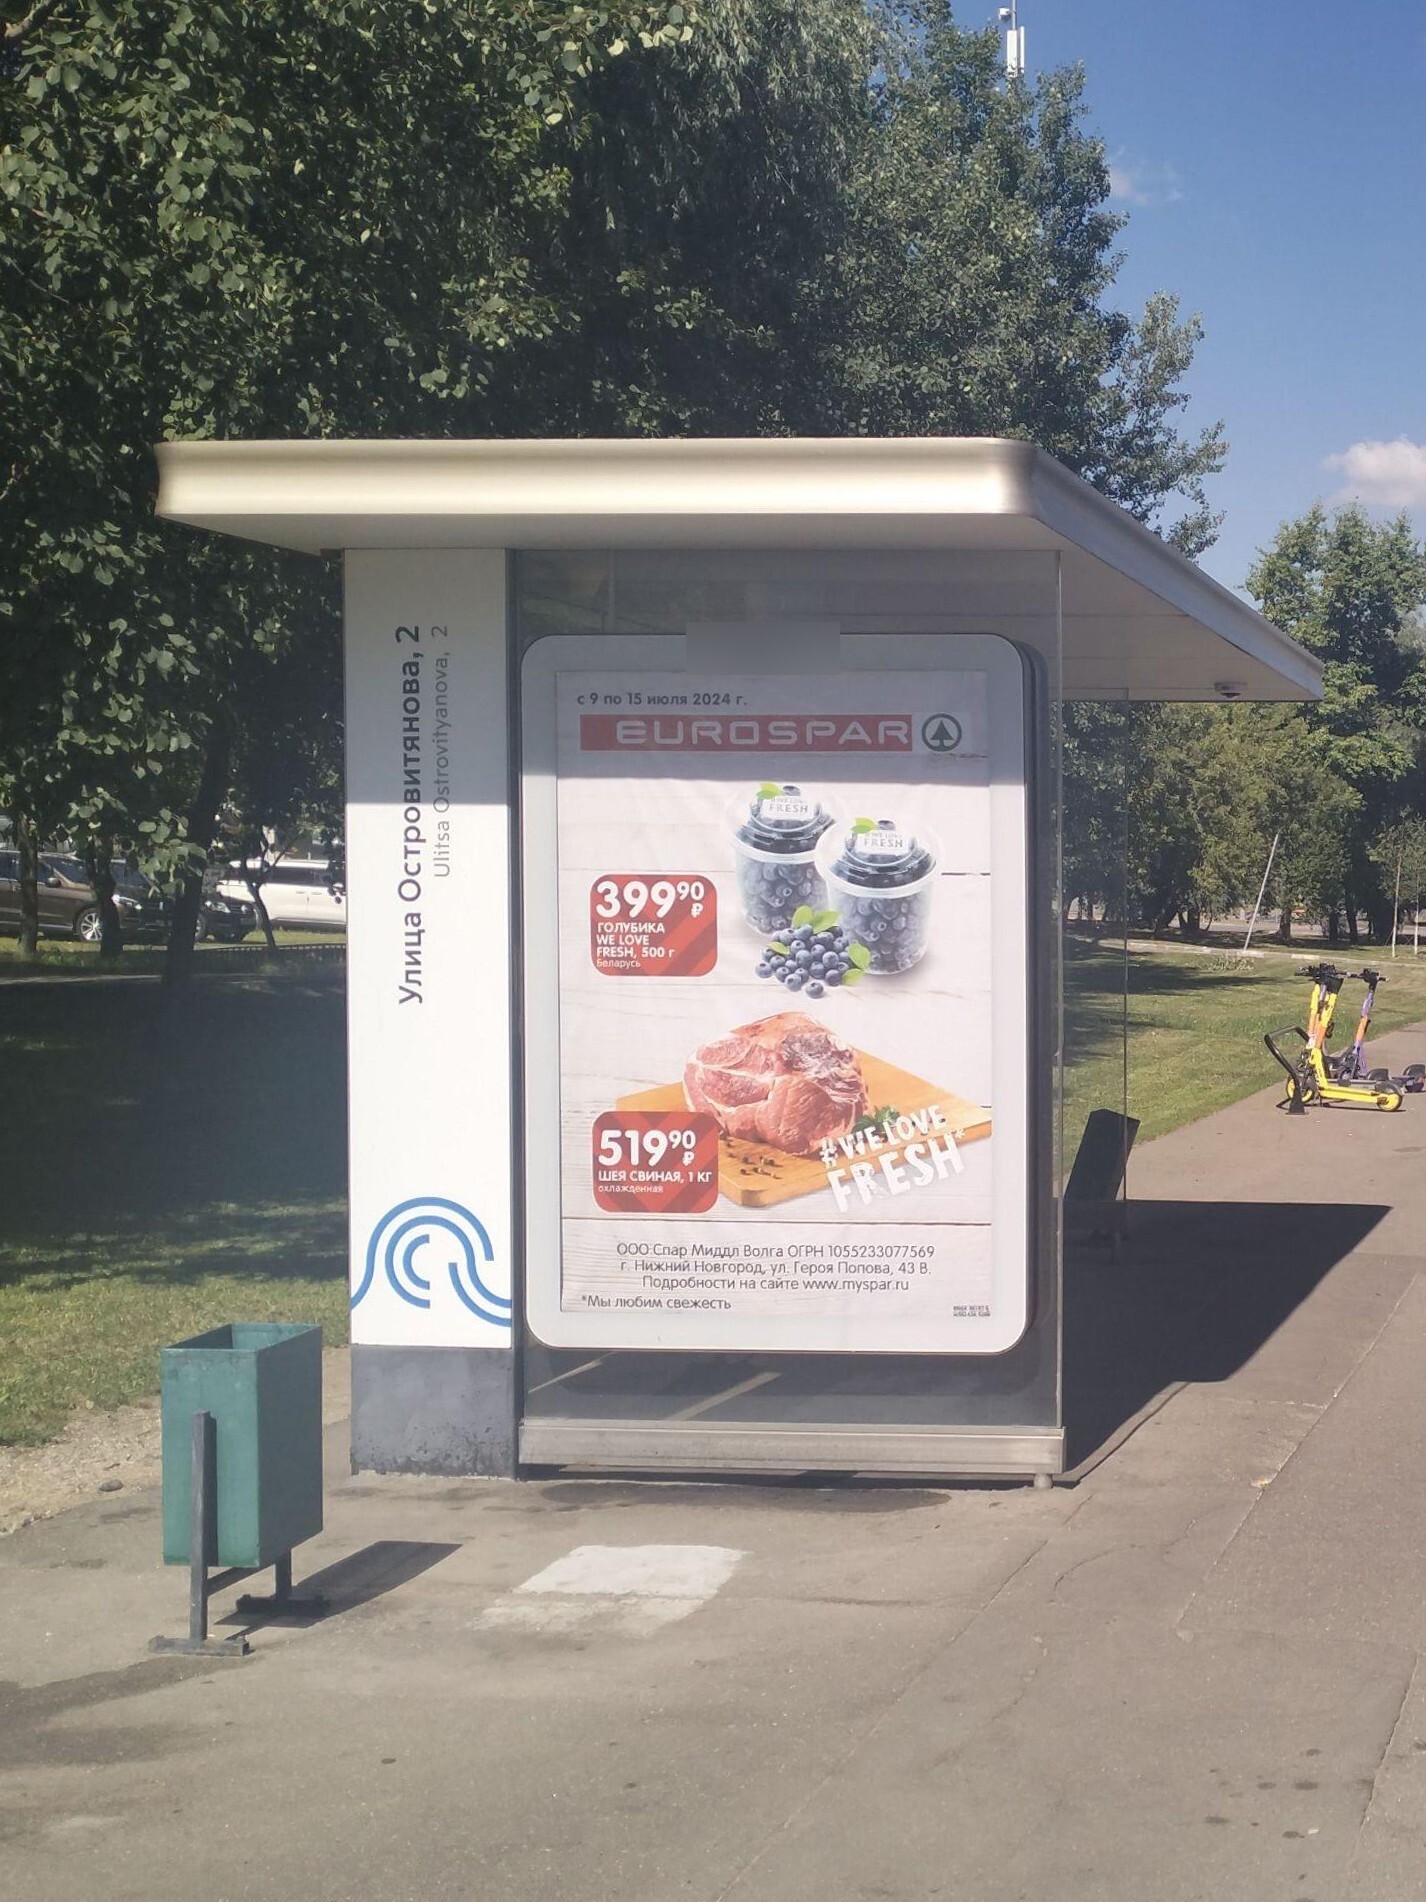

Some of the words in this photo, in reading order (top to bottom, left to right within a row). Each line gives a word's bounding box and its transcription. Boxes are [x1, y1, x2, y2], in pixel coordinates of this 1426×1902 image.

[395, 625, 420, 644] 2
[431, 625, 449, 638] 2
[590, 692, 599, 705] 9
[604, 694, 622, 705] по
[627, 692, 642, 705] 15
[647, 694, 688, 705] июля
[693, 692, 731, 705] 2024
[736, 694, 748, 706] г.
[432, 651, 452, 814] Ostrovityanova,
[616, 719, 909, 746] EUROSPAR
[397, 652, 427, 902] Островитянова,
[768, 804, 808, 813] FRESH
[434, 820, 451, 878] Ulitsa
[864, 839, 903, 848] FRESH
[597, 922, 665, 934] ГОЛУБИКА
[596, 934, 616, 946] WE
[619, 934, 650, 946] LOVE
[398, 911, 424, 1004] Улица
[596, 946, 638, 959] FRESH,
[641, 946, 665, 958] 500
[596, 959, 641, 970] Беларусь
[882, 1104, 947, 1146] LOVE
[598, 1170, 626, 1182] ШЕЯ
[629, 1171, 685, 1184] СВИНАЯ,
[688, 1172, 694, 1182] 1
[697, 1172, 713, 1183] КГ
[616, 1243, 649, 1256] ООО
[653, 1243, 688, 1259] Спар
[691, 1244, 739, 1259] Миддл
[743, 1244, 784, 1258] Волга
[787, 1244, 824, 1258] ОГРН
[829, 1245, 935, 1258] 1055233077569
[634, 1259, 690, 1273] Нижний
[694, 1261, 766, 1275] Новгород,
[770, 1264, 789, 1276] ул.
[793, 1261, 834, 1276] Героя
[838, 1261, 894, 1276] Попова,
[898, 1262, 915, 1274] 43
[642, 1275, 736, 1291] Подробности
[739, 1279, 756, 1290] на
[760, 1277, 799, 1290] сайте
[802, 1279, 910, 1293] www.myspar.ru
[614, 1296, 663, 1309] любим
[666, 1298, 732, 1310] свежесть
